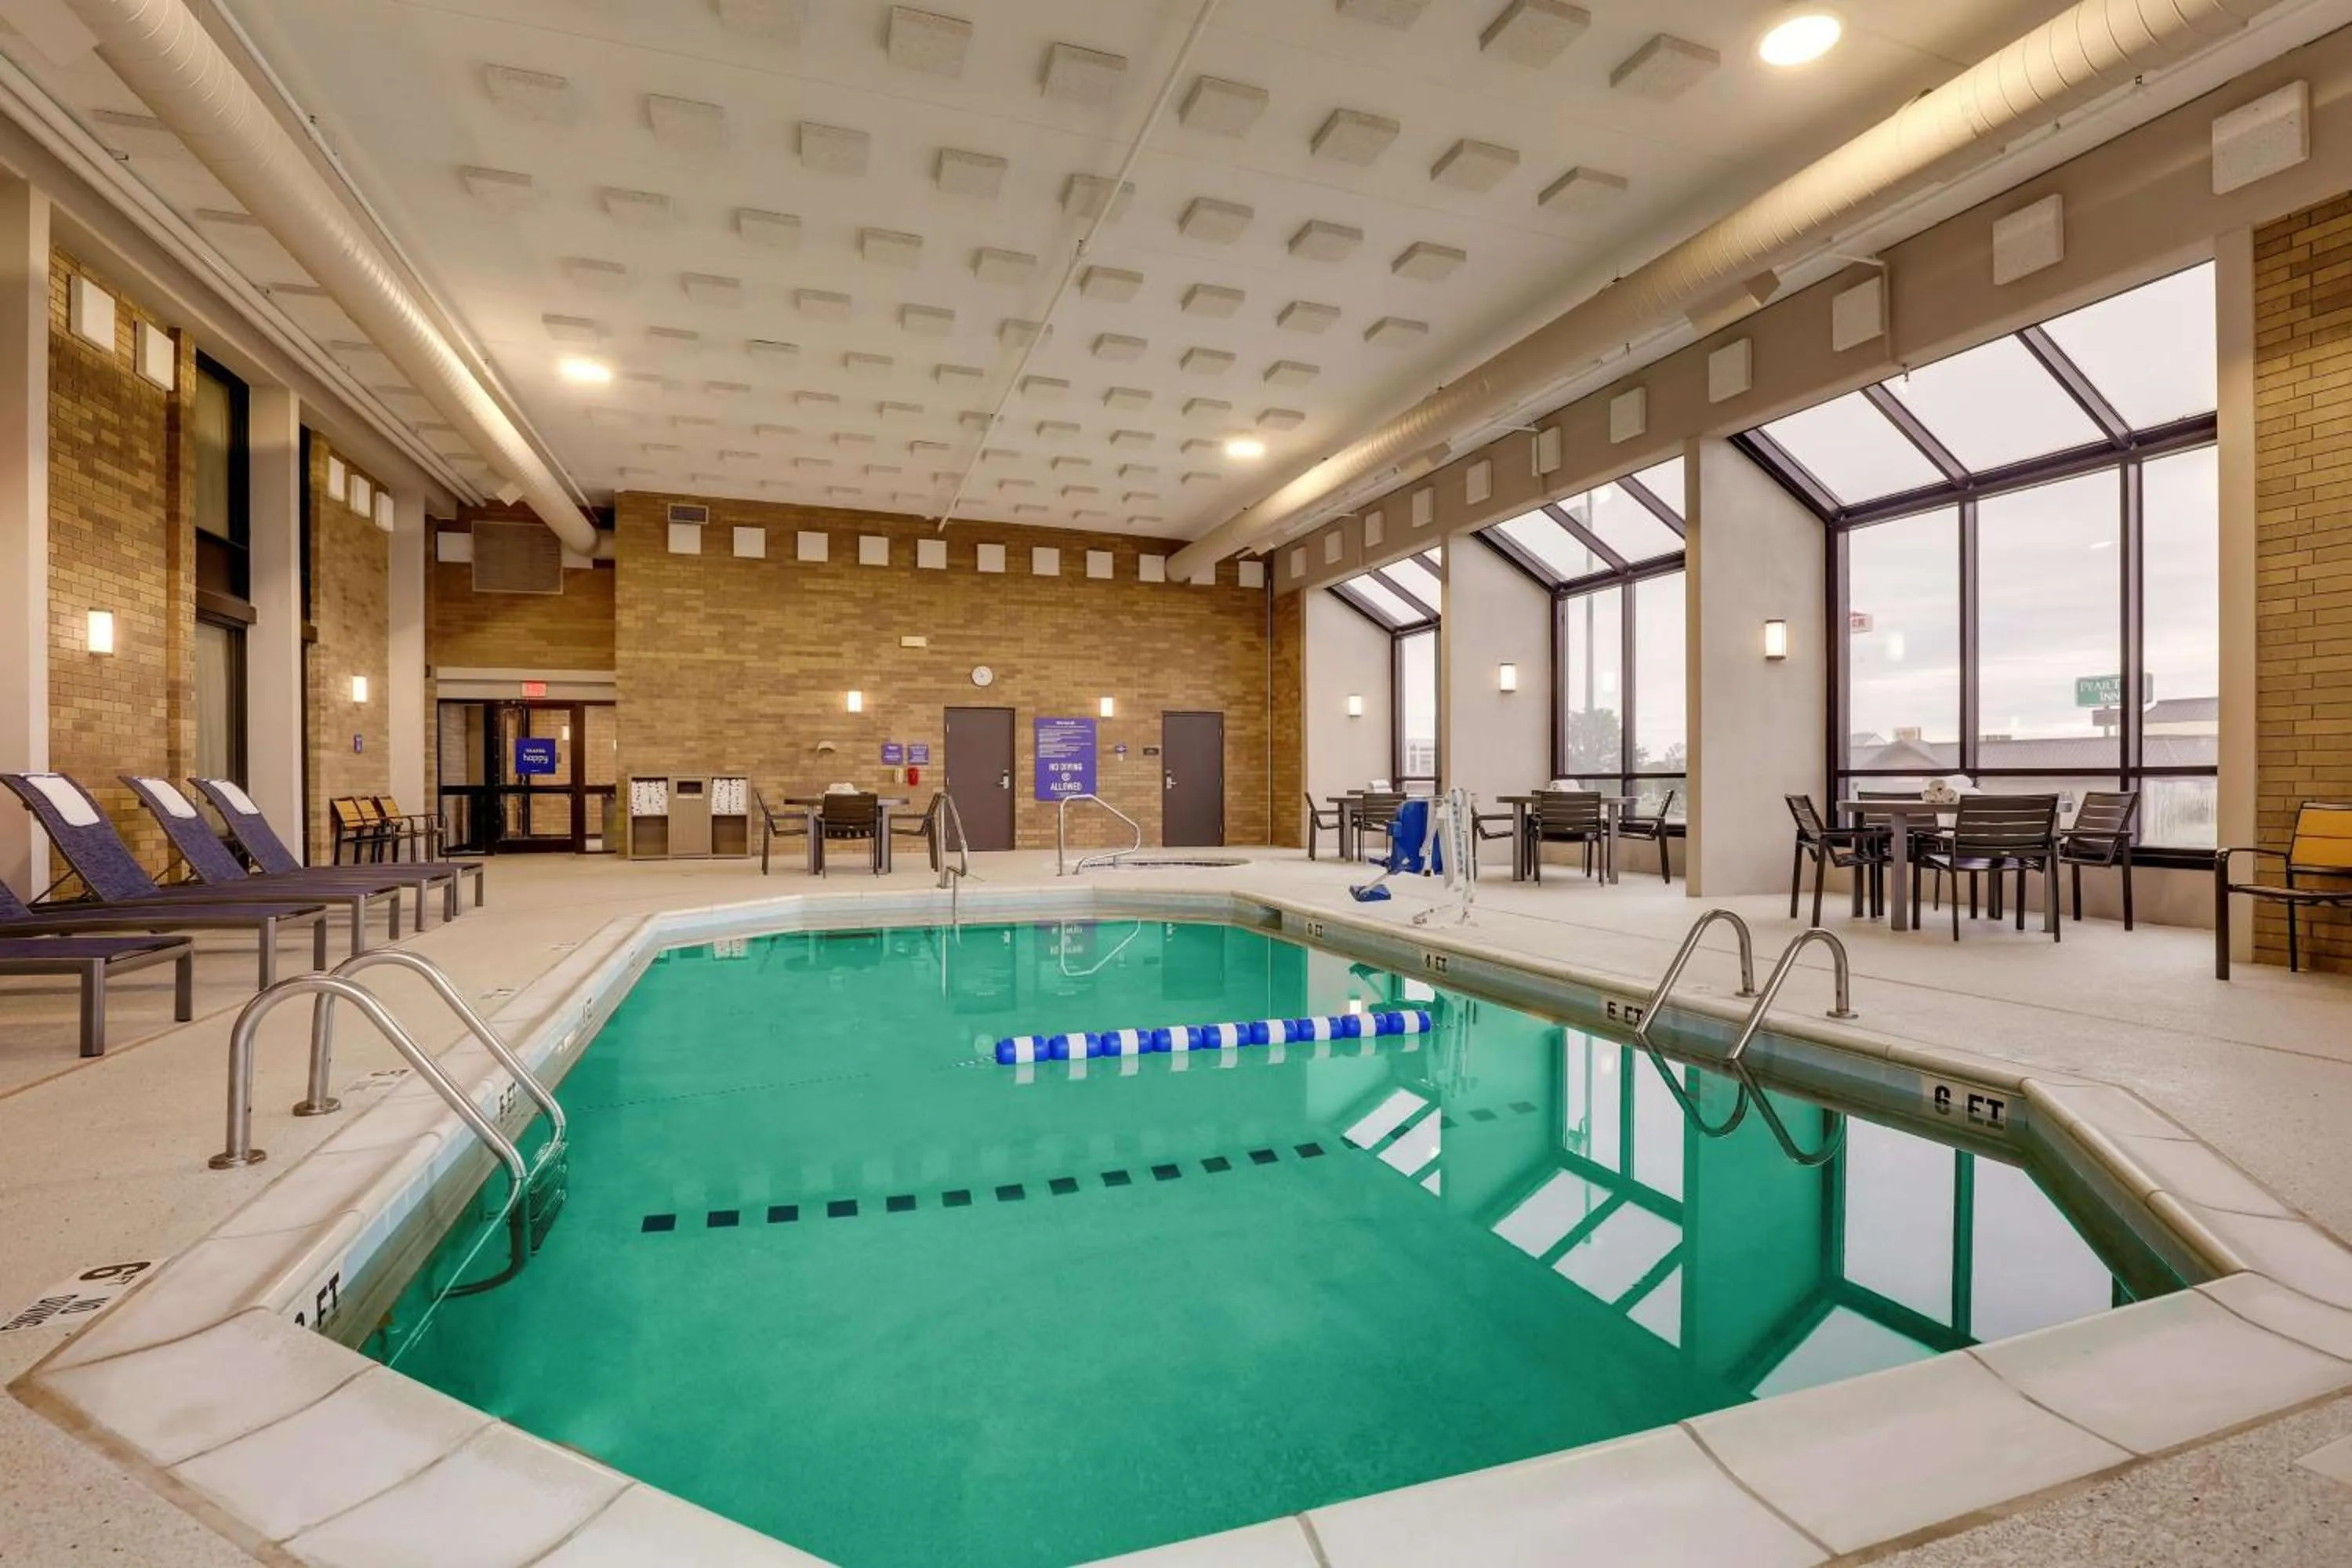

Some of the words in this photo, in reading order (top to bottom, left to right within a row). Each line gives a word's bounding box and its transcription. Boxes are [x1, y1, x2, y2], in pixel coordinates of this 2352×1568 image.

[523, 753, 549, 764] happy
[1048, 763, 1059, 771] NO
[1060, 763, 1083, 771] DIVING
[1051, 782, 1083, 791] ALLOWED
[1934, 1085, 1951, 1115] 6
[1966, 1093, 2004, 1120] FT
[317, 1272, 339, 1328] FT
